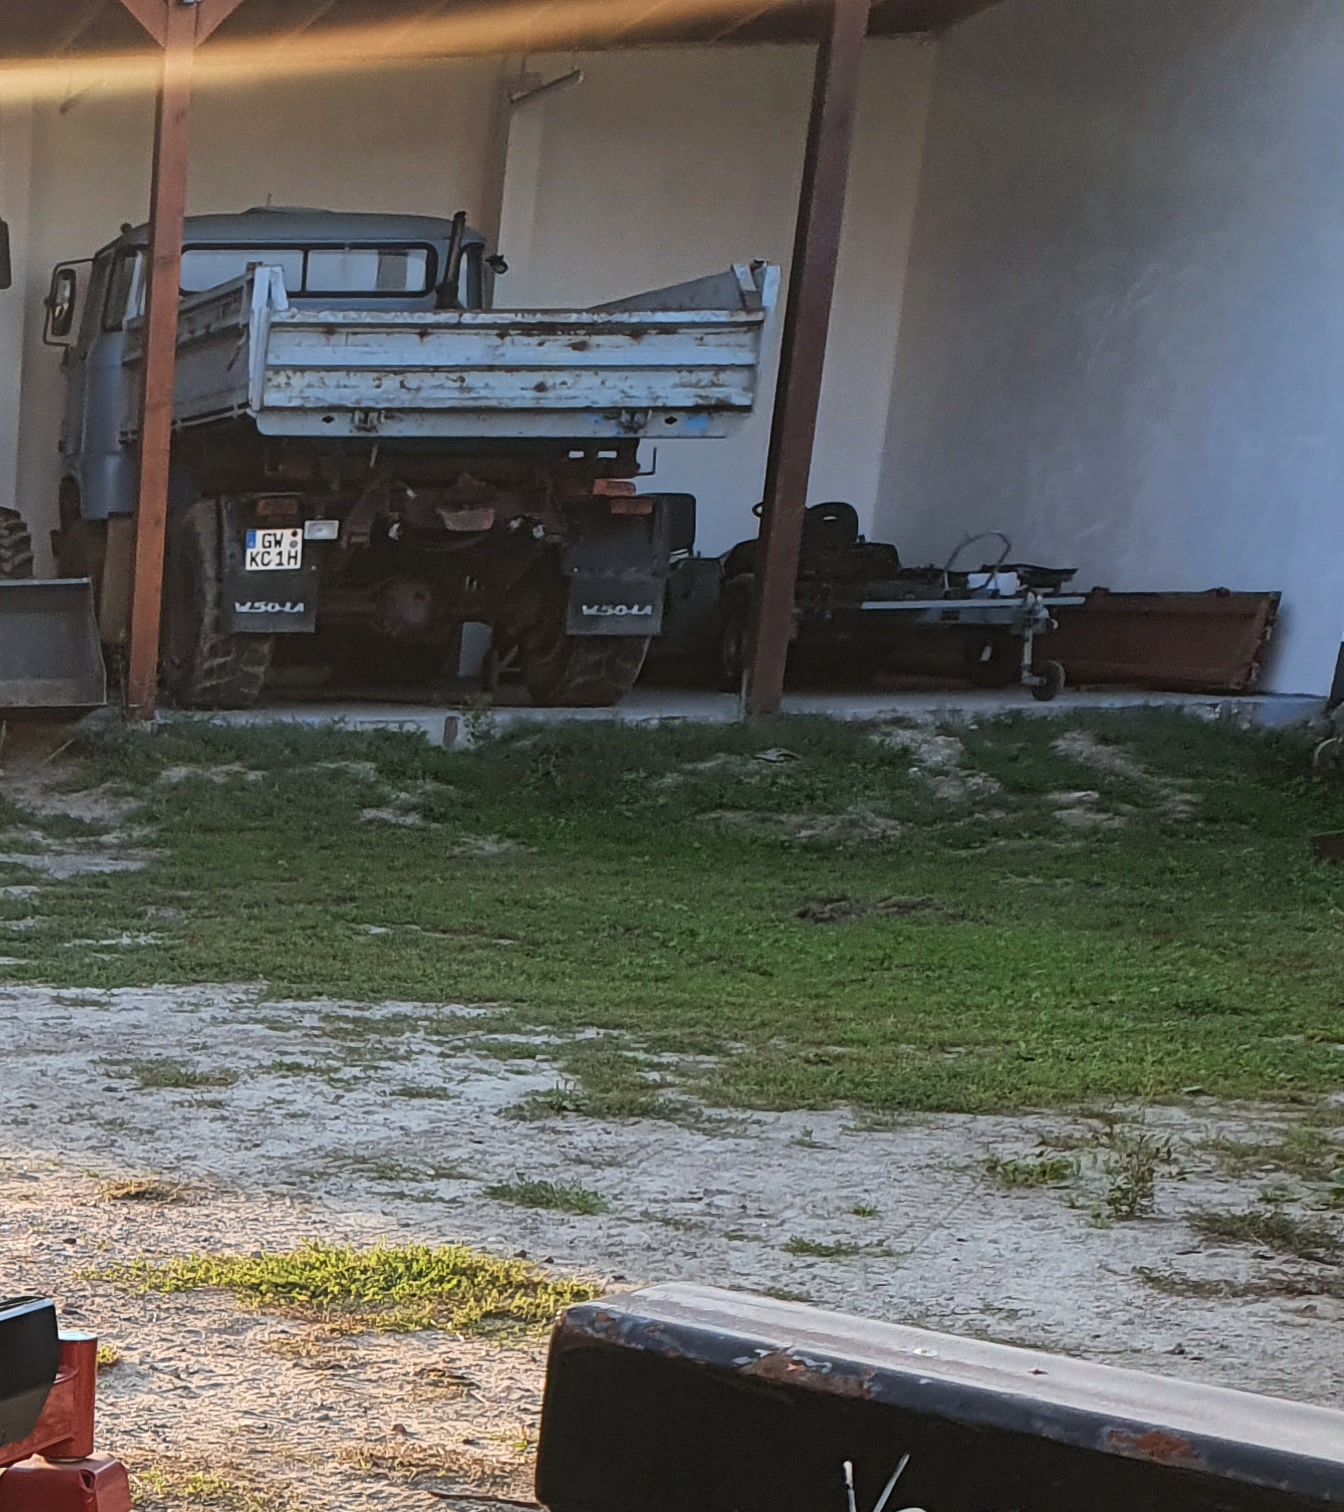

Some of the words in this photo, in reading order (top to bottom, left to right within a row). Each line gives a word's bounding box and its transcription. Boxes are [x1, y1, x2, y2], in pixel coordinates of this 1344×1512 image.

[261, 532, 284, 549] GW
[249, 551, 273, 567] KC
[275, 549, 298, 566] 1H
